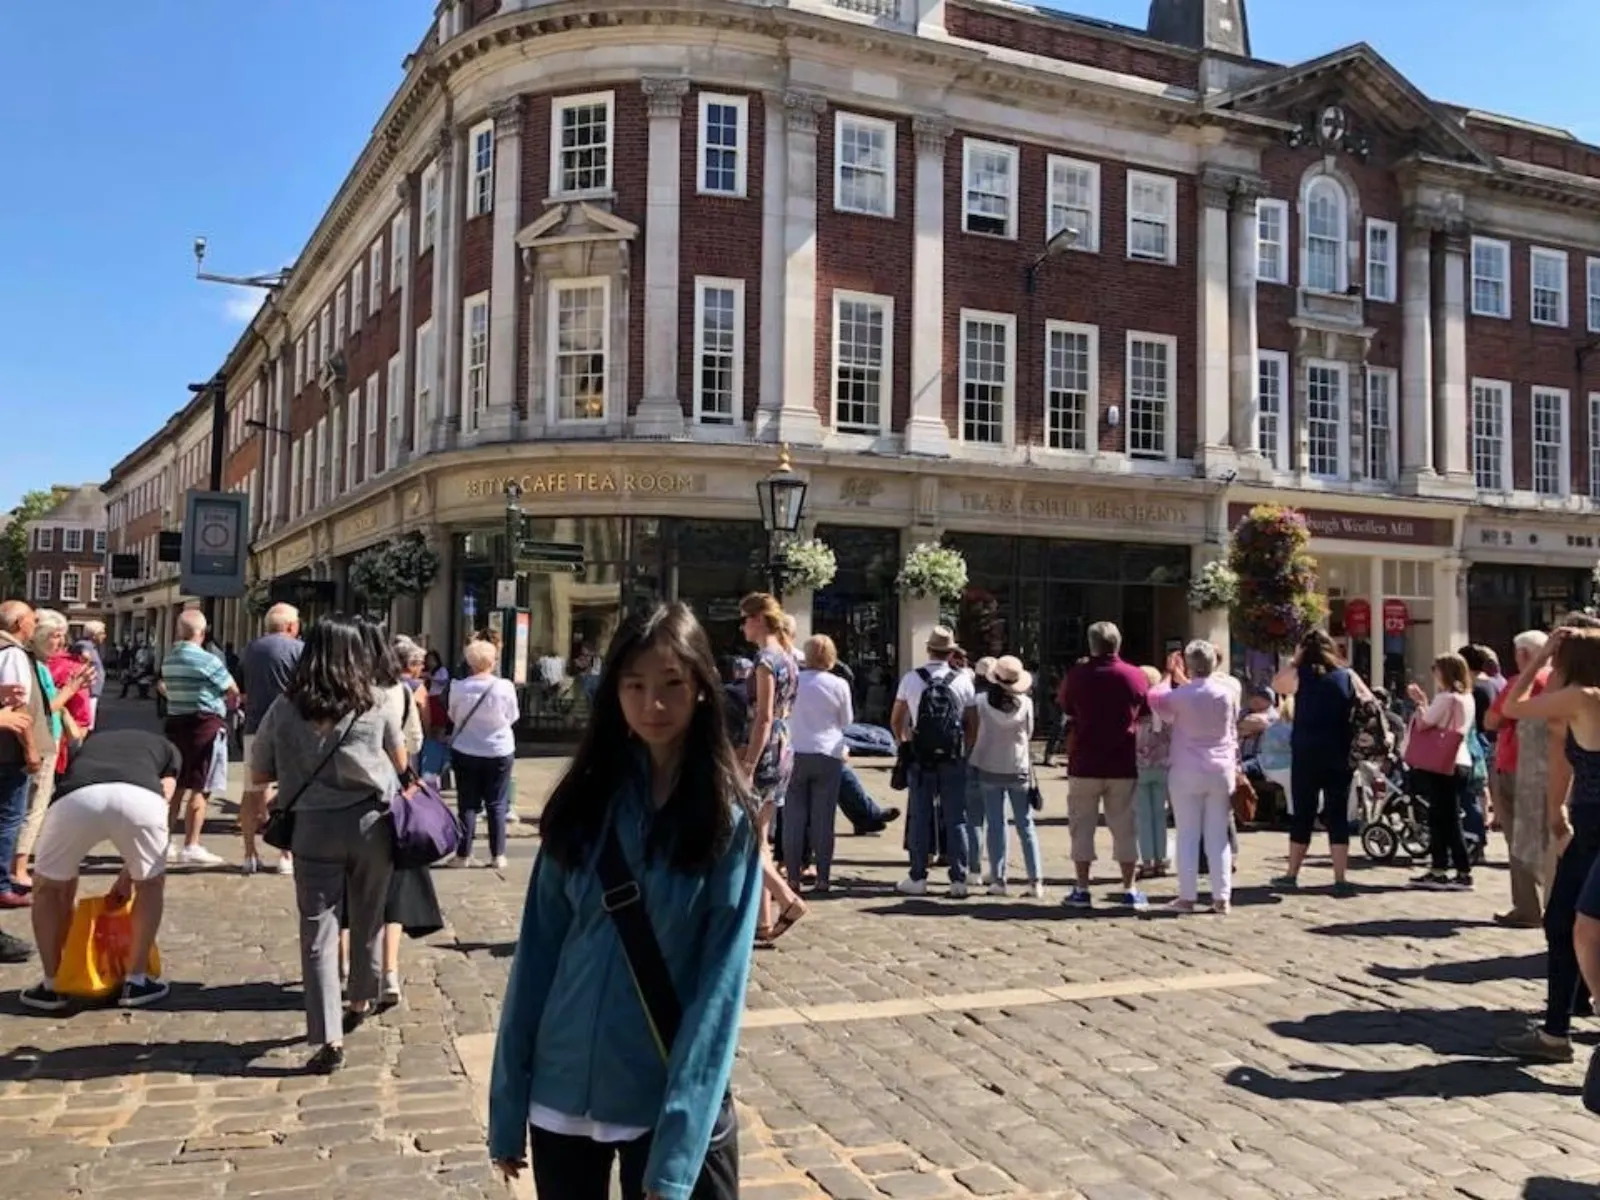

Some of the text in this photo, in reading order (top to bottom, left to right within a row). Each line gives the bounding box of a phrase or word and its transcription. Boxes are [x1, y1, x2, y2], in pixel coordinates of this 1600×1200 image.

[520, 474, 568, 493] CAFE
[574, 473, 616, 491] TEA
[624, 474, 694, 492] ROOM
[1342, 518, 1387, 534] Woollen
[1391, 521, 1415, 536] Mill
